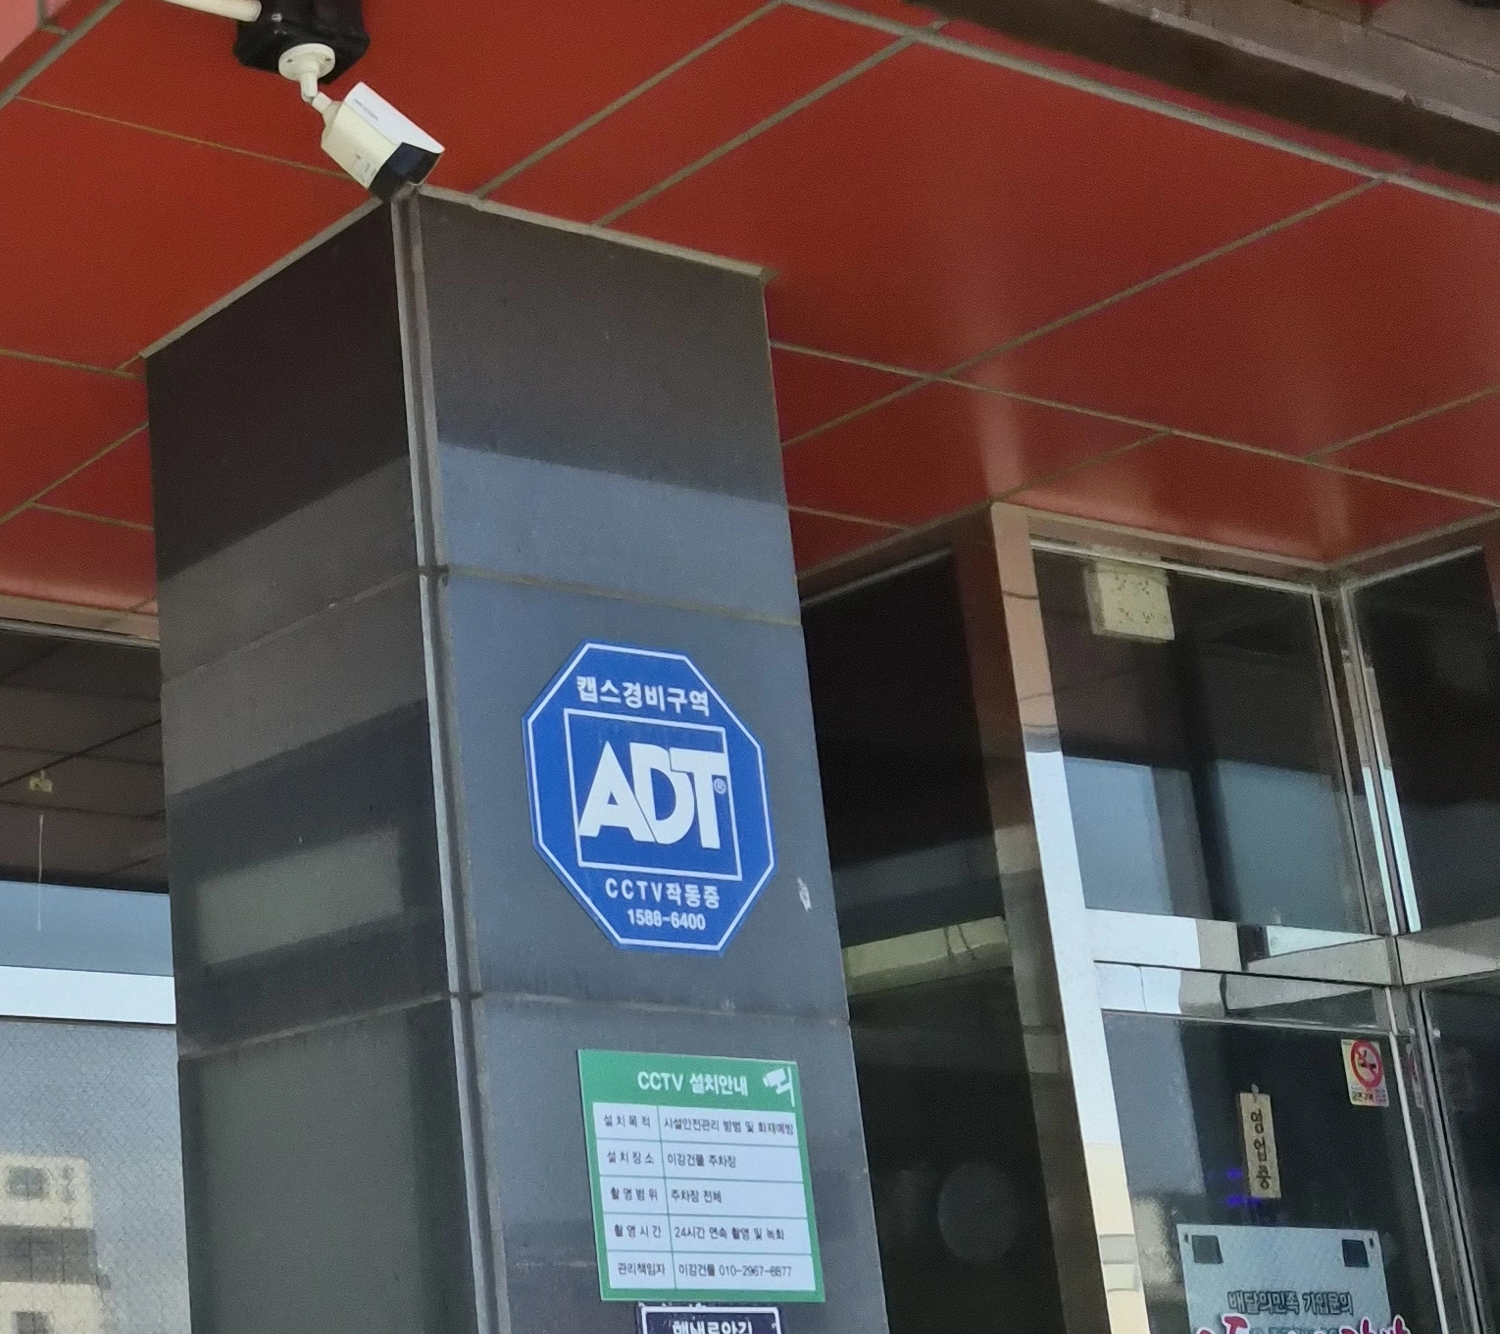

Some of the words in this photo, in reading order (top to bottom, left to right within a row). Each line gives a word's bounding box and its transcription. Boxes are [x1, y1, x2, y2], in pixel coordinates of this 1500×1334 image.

[577, 675, 710, 717] 캡스경비구역
[578, 740, 728, 850] ADT
[605, 877, 720, 910] CCTV작동중
[627, 908, 707, 931] 1588-6400
[637, 1071, 684, 1092] CCTV
[689, 1072, 749, 1097] 설치안내
[708, 1154, 736, 1168] 주차장
[1250, 1108, 1272, 1191] 영업중
[671, 1189, 699, 1203] 주차장
[675, 1226, 706, 1240] 24시간
[1227, 1290, 1300, 1315] 배달의민족
[1302, 1291, 1355, 1316] 가입문의
